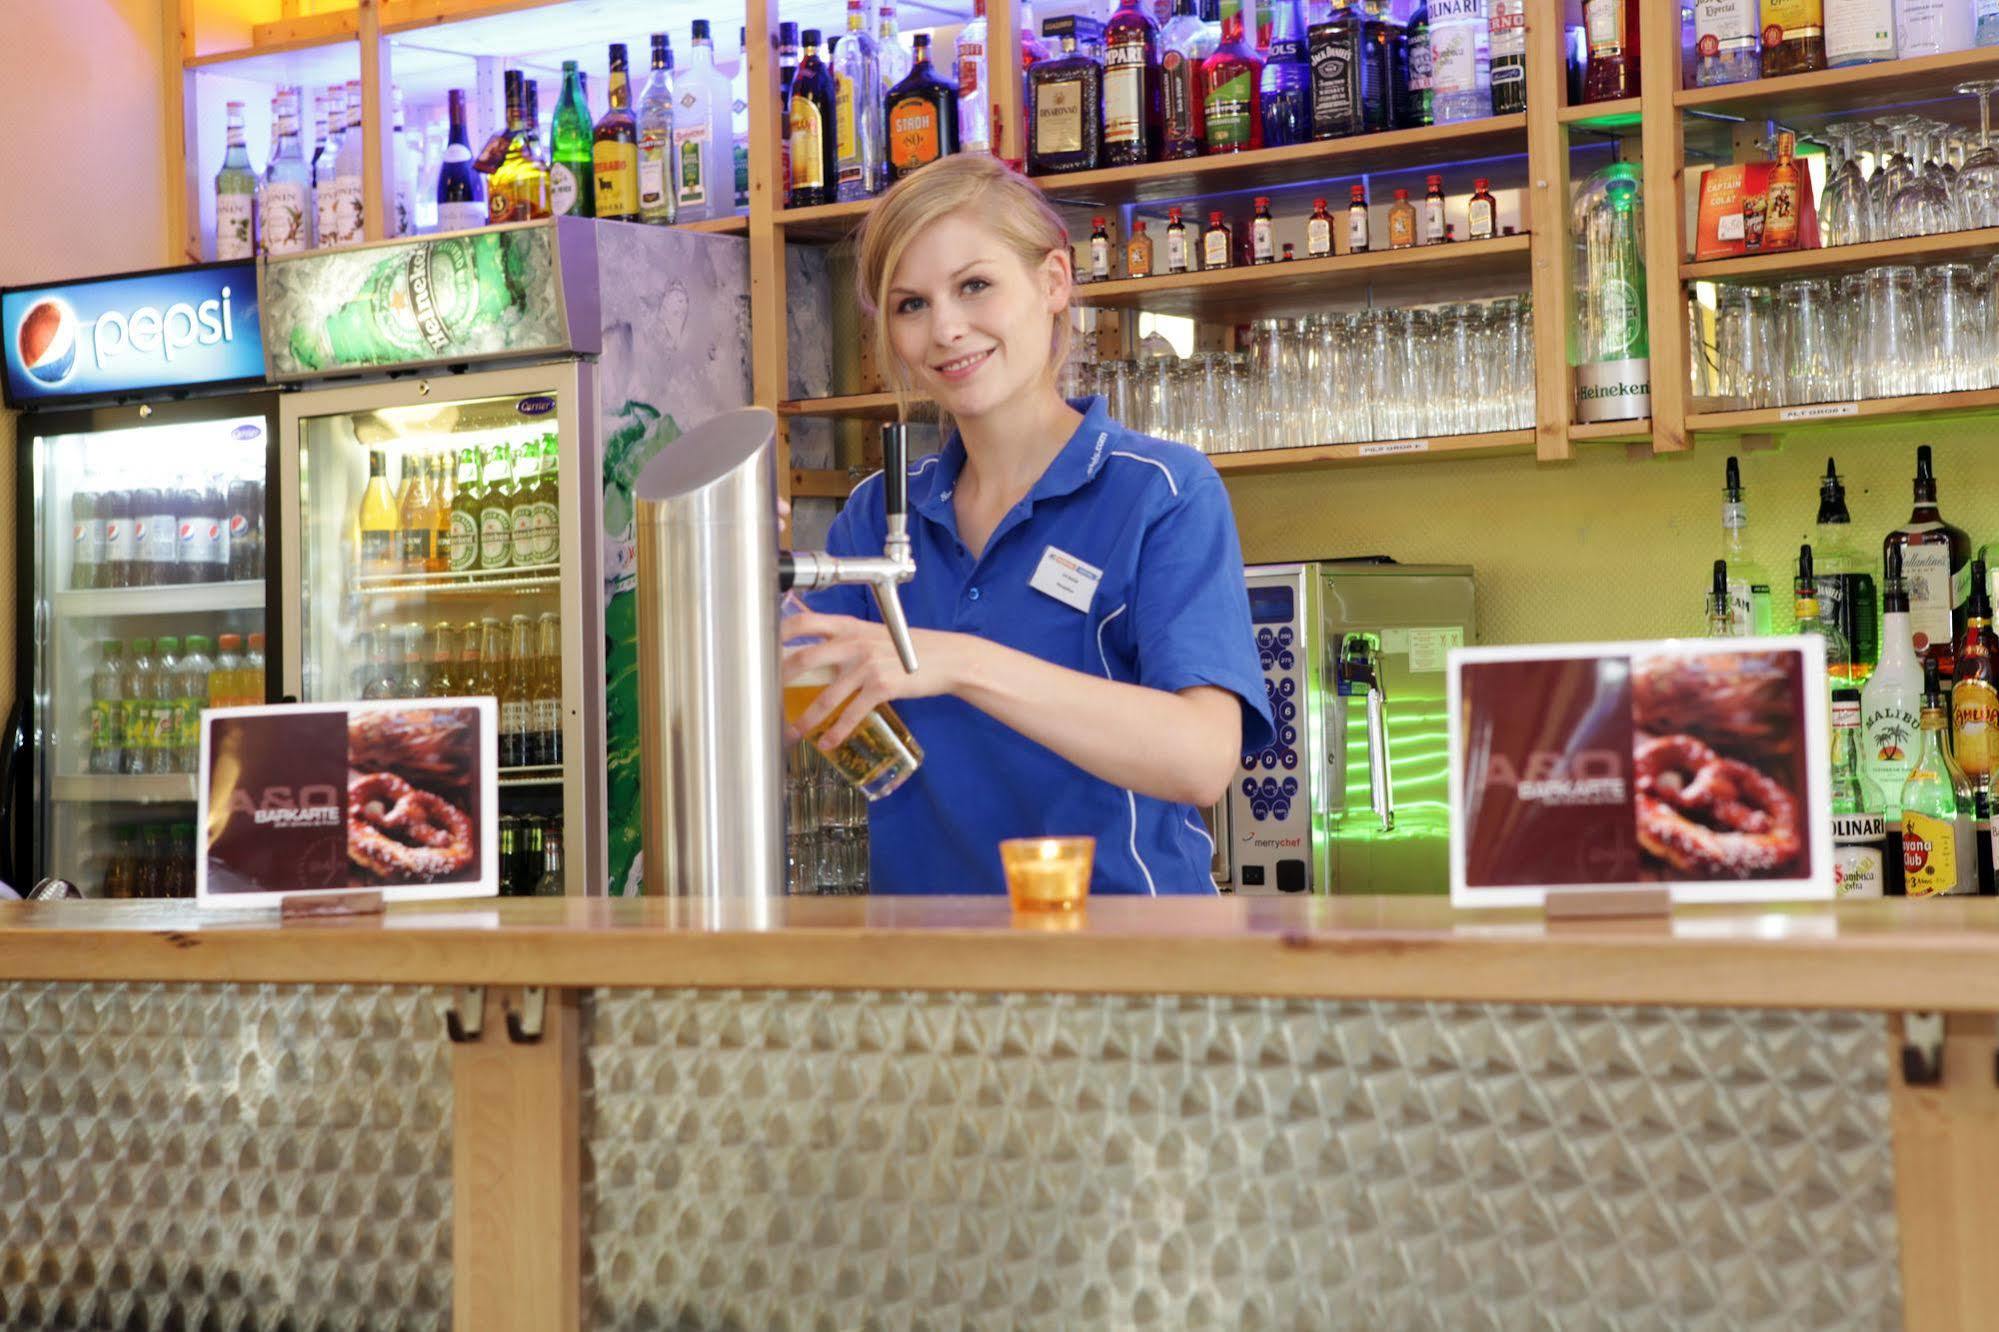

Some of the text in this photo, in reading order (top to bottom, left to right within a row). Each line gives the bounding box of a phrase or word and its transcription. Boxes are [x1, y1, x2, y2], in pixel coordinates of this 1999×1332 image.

[895, 115, 930, 132] STROH
[94, 285, 232, 369] pepsi
[1579, 381, 1650, 400] Heineken
[1284, 682, 1290, 692] 3
[1285, 705, 1291, 715] 6
[1866, 708, 1920, 730] MALIBU
[1285, 731, 1292, 741] 9
[1245, 755, 1253, 764] P
[1285, 754, 1294, 764] C
[254, 807, 339, 824] BARKARTE
[1254, 838, 1301, 849] merrychef
